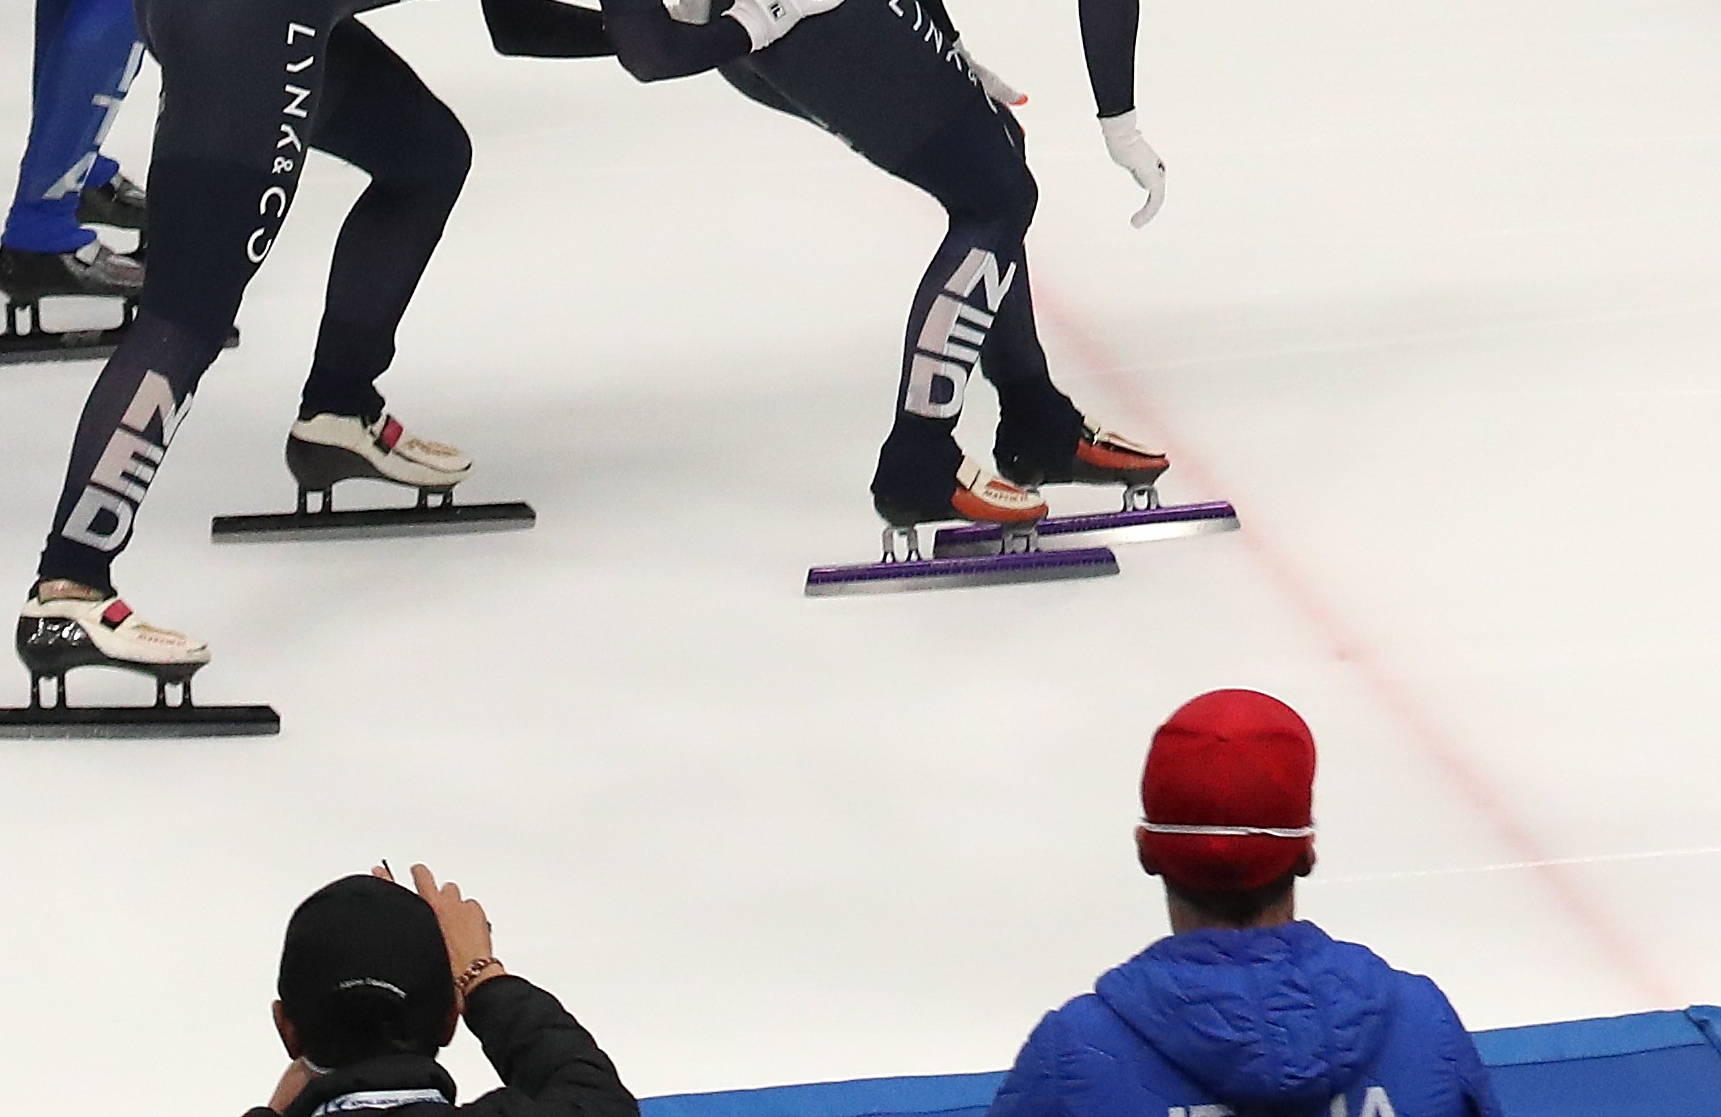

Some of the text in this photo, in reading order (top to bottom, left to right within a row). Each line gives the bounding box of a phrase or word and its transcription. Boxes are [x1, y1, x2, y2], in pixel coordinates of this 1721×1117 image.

[41, 41, 145, 200] ITA
[905, 247, 1017, 420] NED
[61, 369, 193, 553] NED
